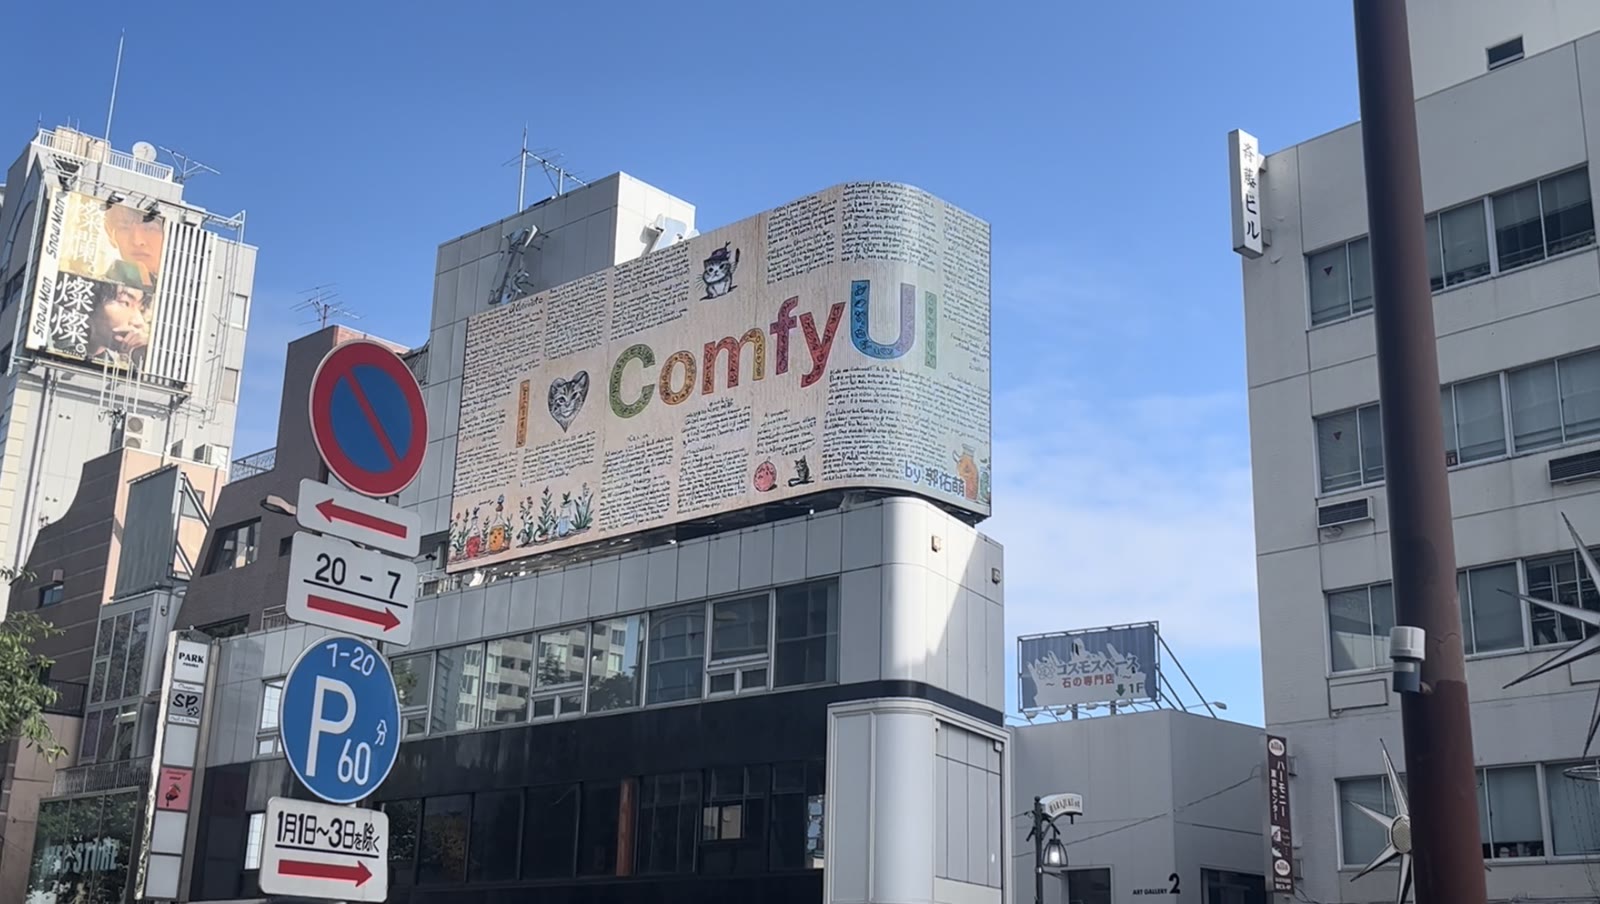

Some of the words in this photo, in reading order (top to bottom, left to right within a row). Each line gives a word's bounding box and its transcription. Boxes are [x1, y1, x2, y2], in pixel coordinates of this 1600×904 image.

[45, 224, 61, 260] Snow
[53, 198, 66, 225] Man
[39, 277, 52, 306] Man
[33, 305, 49, 339] Snow
[516, 379, 530, 448] I
[609, 279, 938, 419] ComfyUI
[315, 553, 347, 585] 20
[387, 571, 402, 599] 7
[178, 652, 204, 664] PARK
[1129, 682, 1144, 693] 1F
[305, 674, 357, 777] P
[1277, 760, 1287, 817] ハーモニー
[1168, 873, 1181, 894] 2
